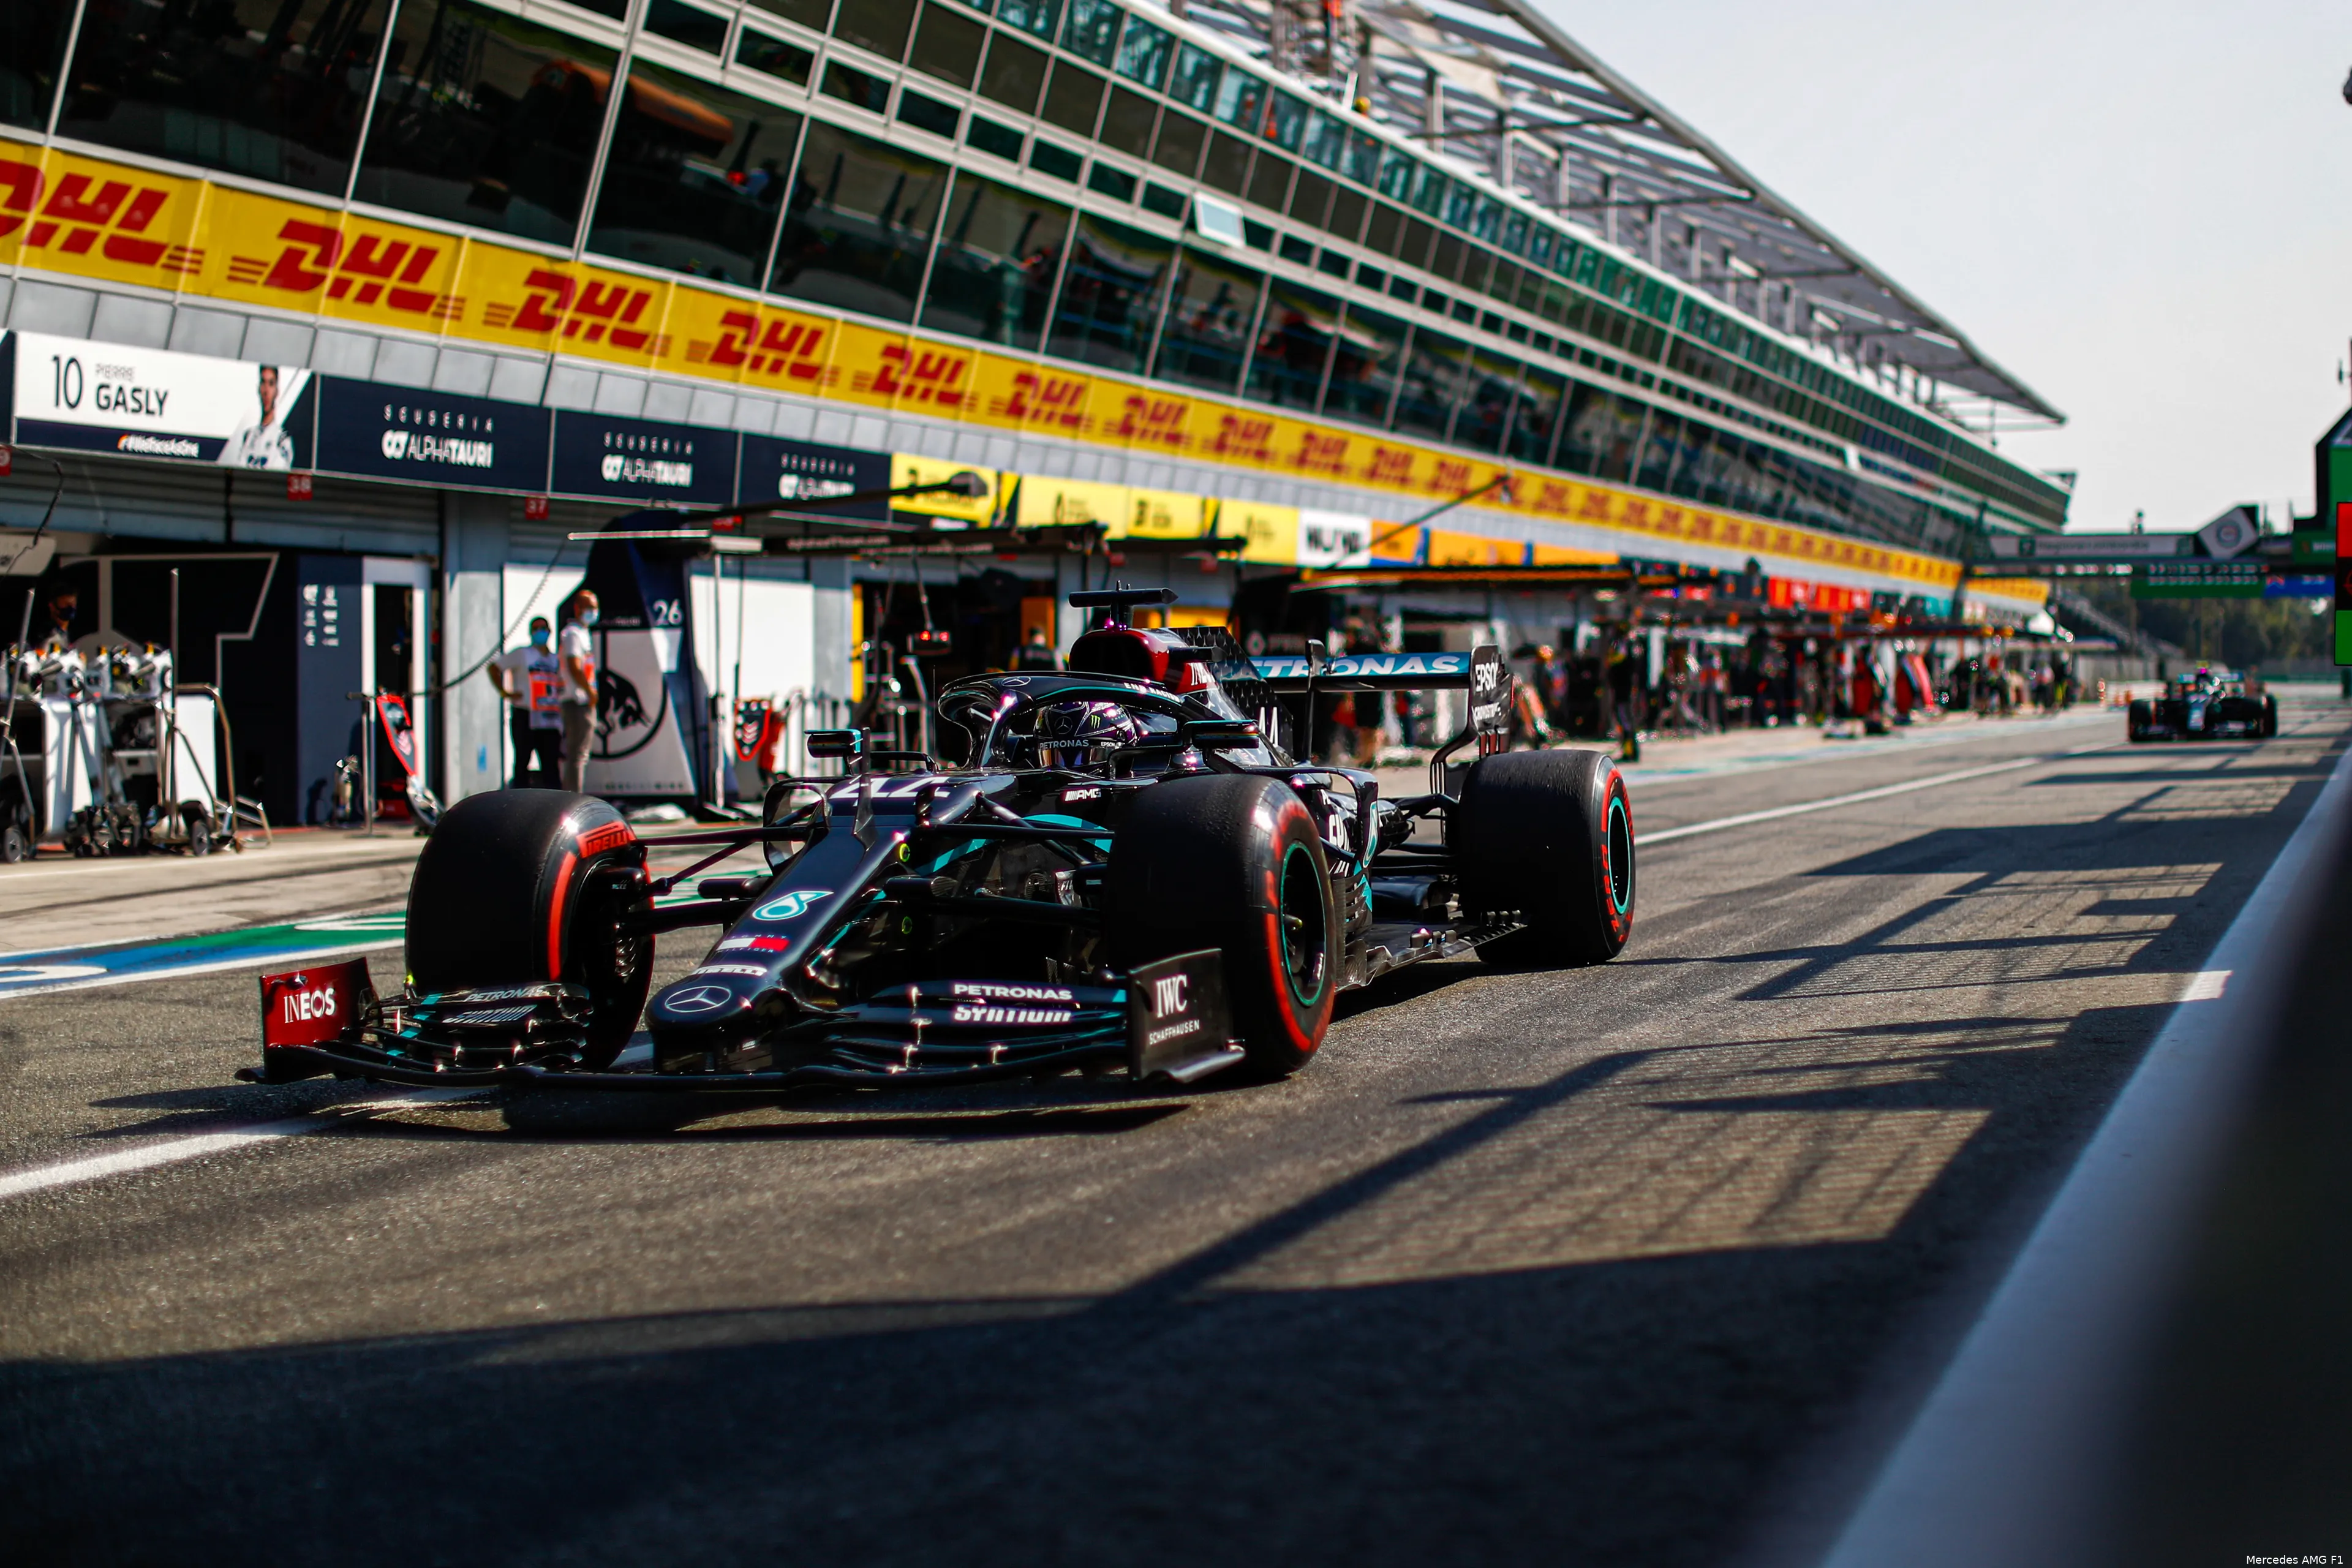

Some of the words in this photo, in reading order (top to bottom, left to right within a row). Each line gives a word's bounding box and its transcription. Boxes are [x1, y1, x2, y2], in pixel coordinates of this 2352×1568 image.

[263, 218, 439, 313] DHL
[512, 269, 652, 350] DHL
[709, 311, 824, 380] DHL
[51, 355, 83, 409] 10
[96, 364, 134, 381] PIERRE
[872, 343, 968, 405] DHL
[96, 383, 168, 417] GASLY
[1006, 372, 1087, 426] DHL
[383, 404, 494, 434] SCUDERIA
[1119, 395, 1187, 444] DHL
[406, 434, 494, 469] ALPHATAURI
[1215, 415, 1274, 459] DHL
[654, 600, 682, 625] 26
[1252, 655, 1460, 678] TRONAS
[1039, 739, 1090, 749] PETRONAS
[1076, 788, 1101, 801] AMG
[691, 964, 767, 977] PIRELLI
[284, 987, 337, 1024] INEOS
[464, 986, 545, 1002] PETRONAS
[954, 983, 1072, 1000] PETRONAS
[1156, 974, 1188, 1019] IWC
[954, 1005, 1072, 1023] SYNTIUM
[1148, 1019, 1200, 1046] SCHAFFHAUSEN
